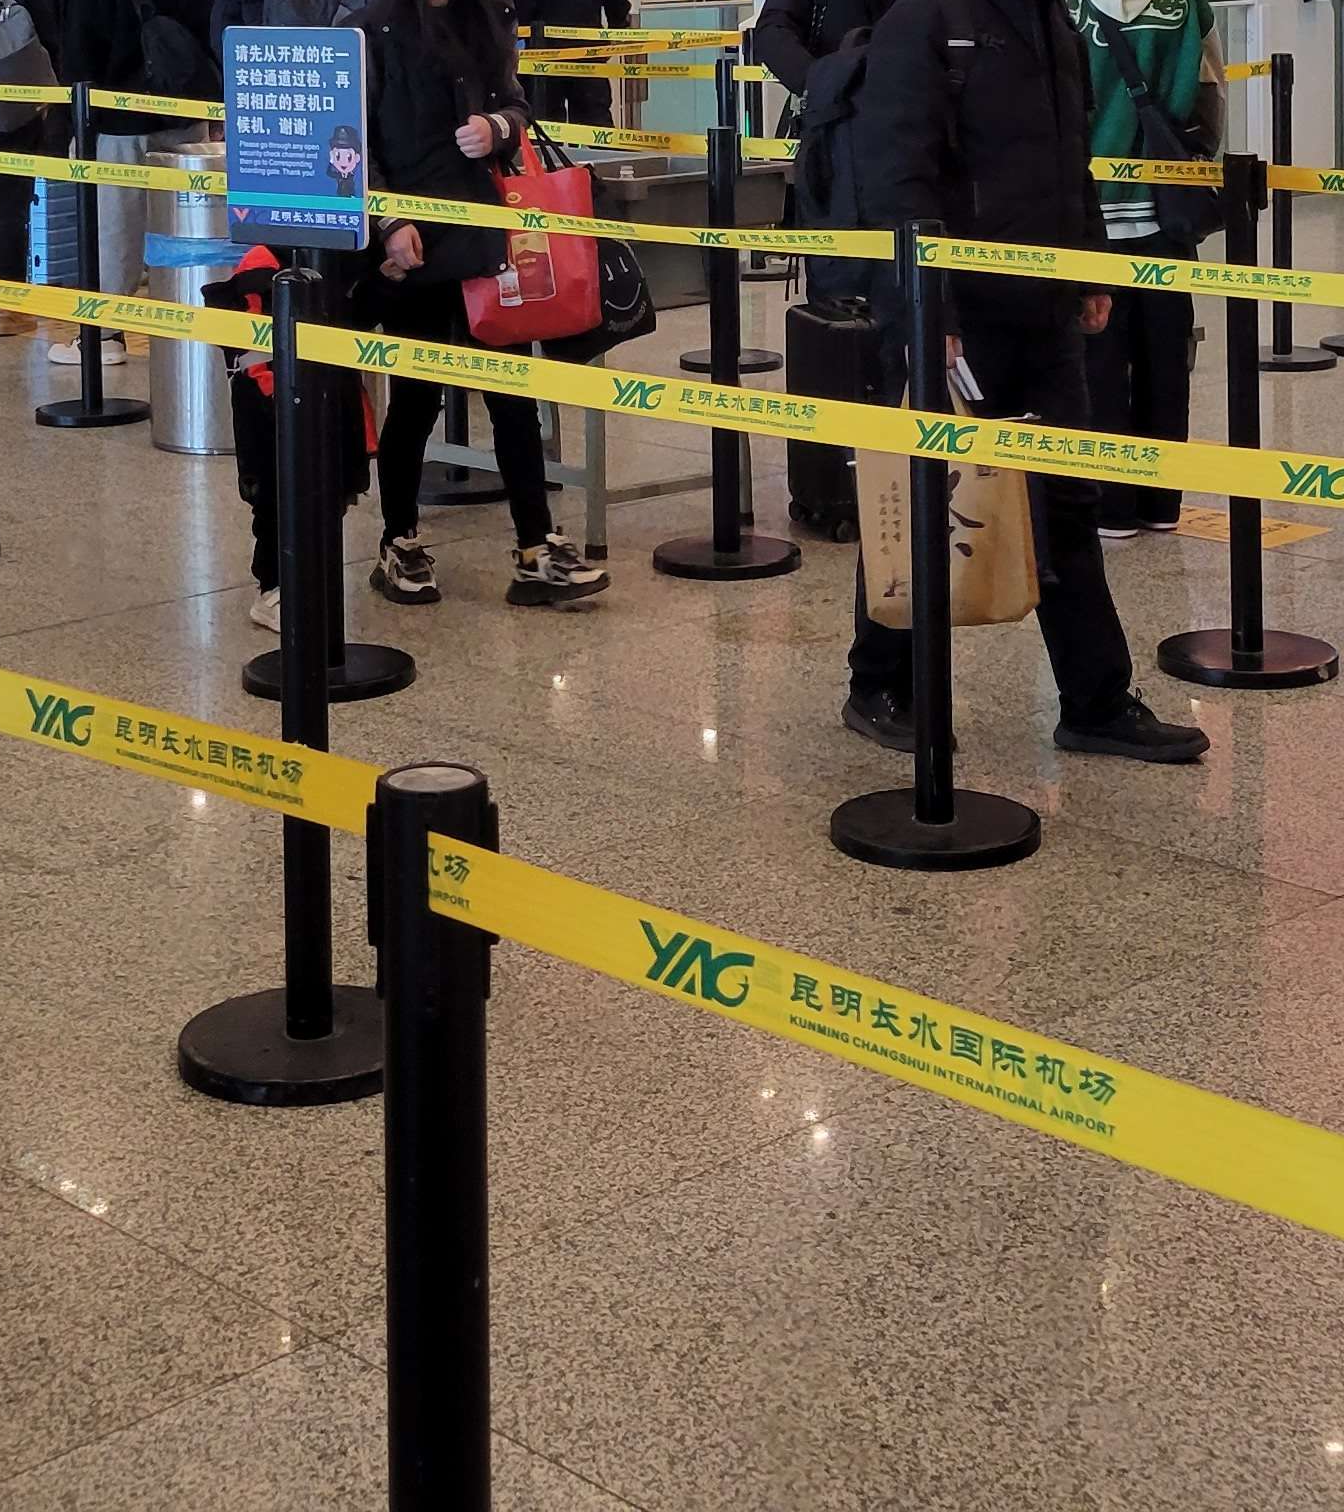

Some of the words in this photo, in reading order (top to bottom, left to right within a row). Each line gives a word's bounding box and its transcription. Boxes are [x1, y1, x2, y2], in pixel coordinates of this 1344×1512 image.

[235, 44, 350, 63] 请先从开放的任一
[235, 69, 350, 89] 安检通道过检，再
[236, 93, 335, 112] 到相应的登机口
[270, 211, 360, 226] 昆明长水国际机场
[1191, 266, 1314, 289] 昆明长水国际机场
[412, 346, 533, 377] 昆明长水国际机场
[678, 387, 818, 421] 昆明长水国际机场
[993, 429, 1160, 465] 昆明长水国际机场
[115, 715, 305, 785] 昆明长水国际机场
[790, 972, 1116, 1106] 昆明长水国际机场
[789, 1013, 850, 1044] KUNMING
[852, 1036, 931, 1075] CHANGSHUI
[933, 1064, 1045, 1115] INTERNATIONAL
[1049, 1106, 1117, 1138] AIRPORT
